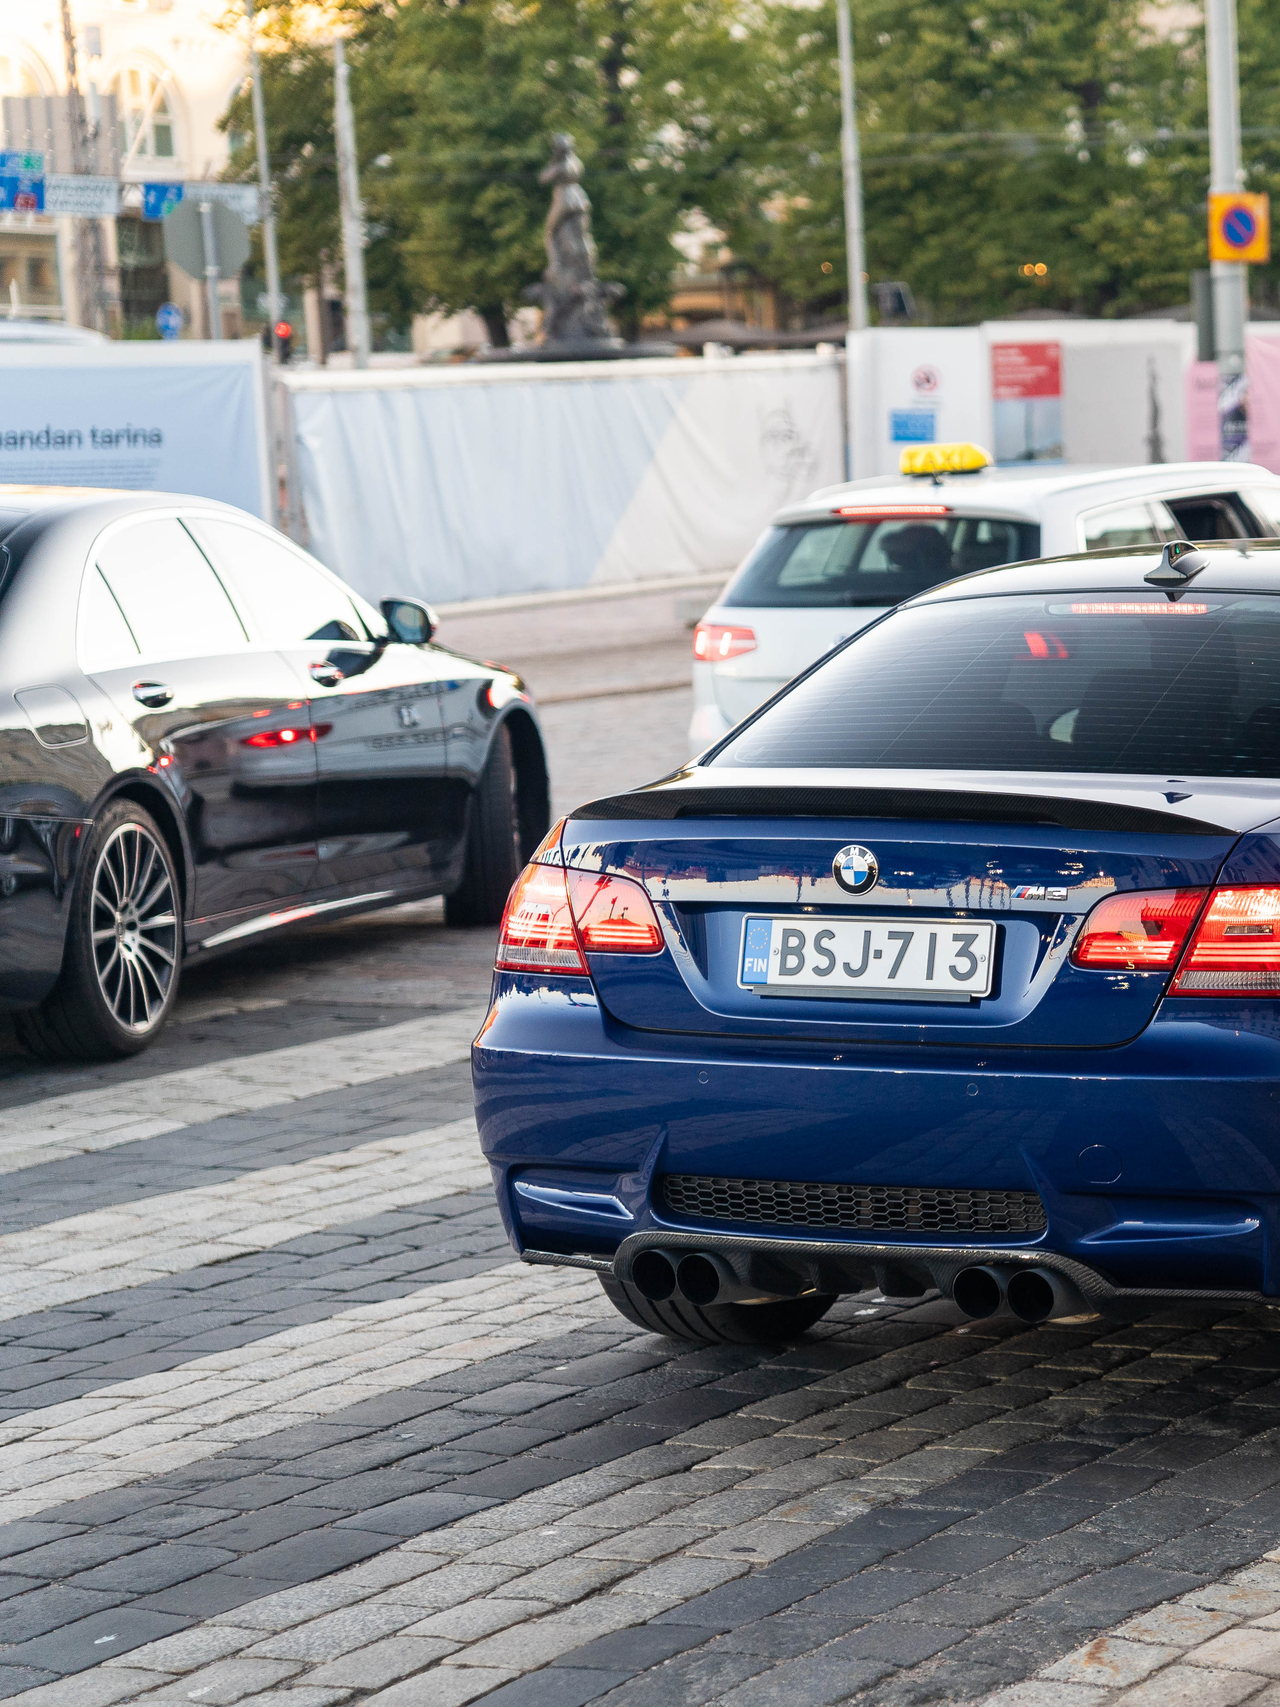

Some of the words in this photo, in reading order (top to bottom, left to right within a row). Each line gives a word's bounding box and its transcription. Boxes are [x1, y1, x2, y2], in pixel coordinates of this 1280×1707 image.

[90, 422, 163, 449] tarina
[905, 448, 966, 473] TAXI
[836, 847, 874, 864] BMW
[1023, 885, 1068, 901] M3
[745, 957, 768, 973] FIN
[778, 928, 980, 982] BSJ-713
